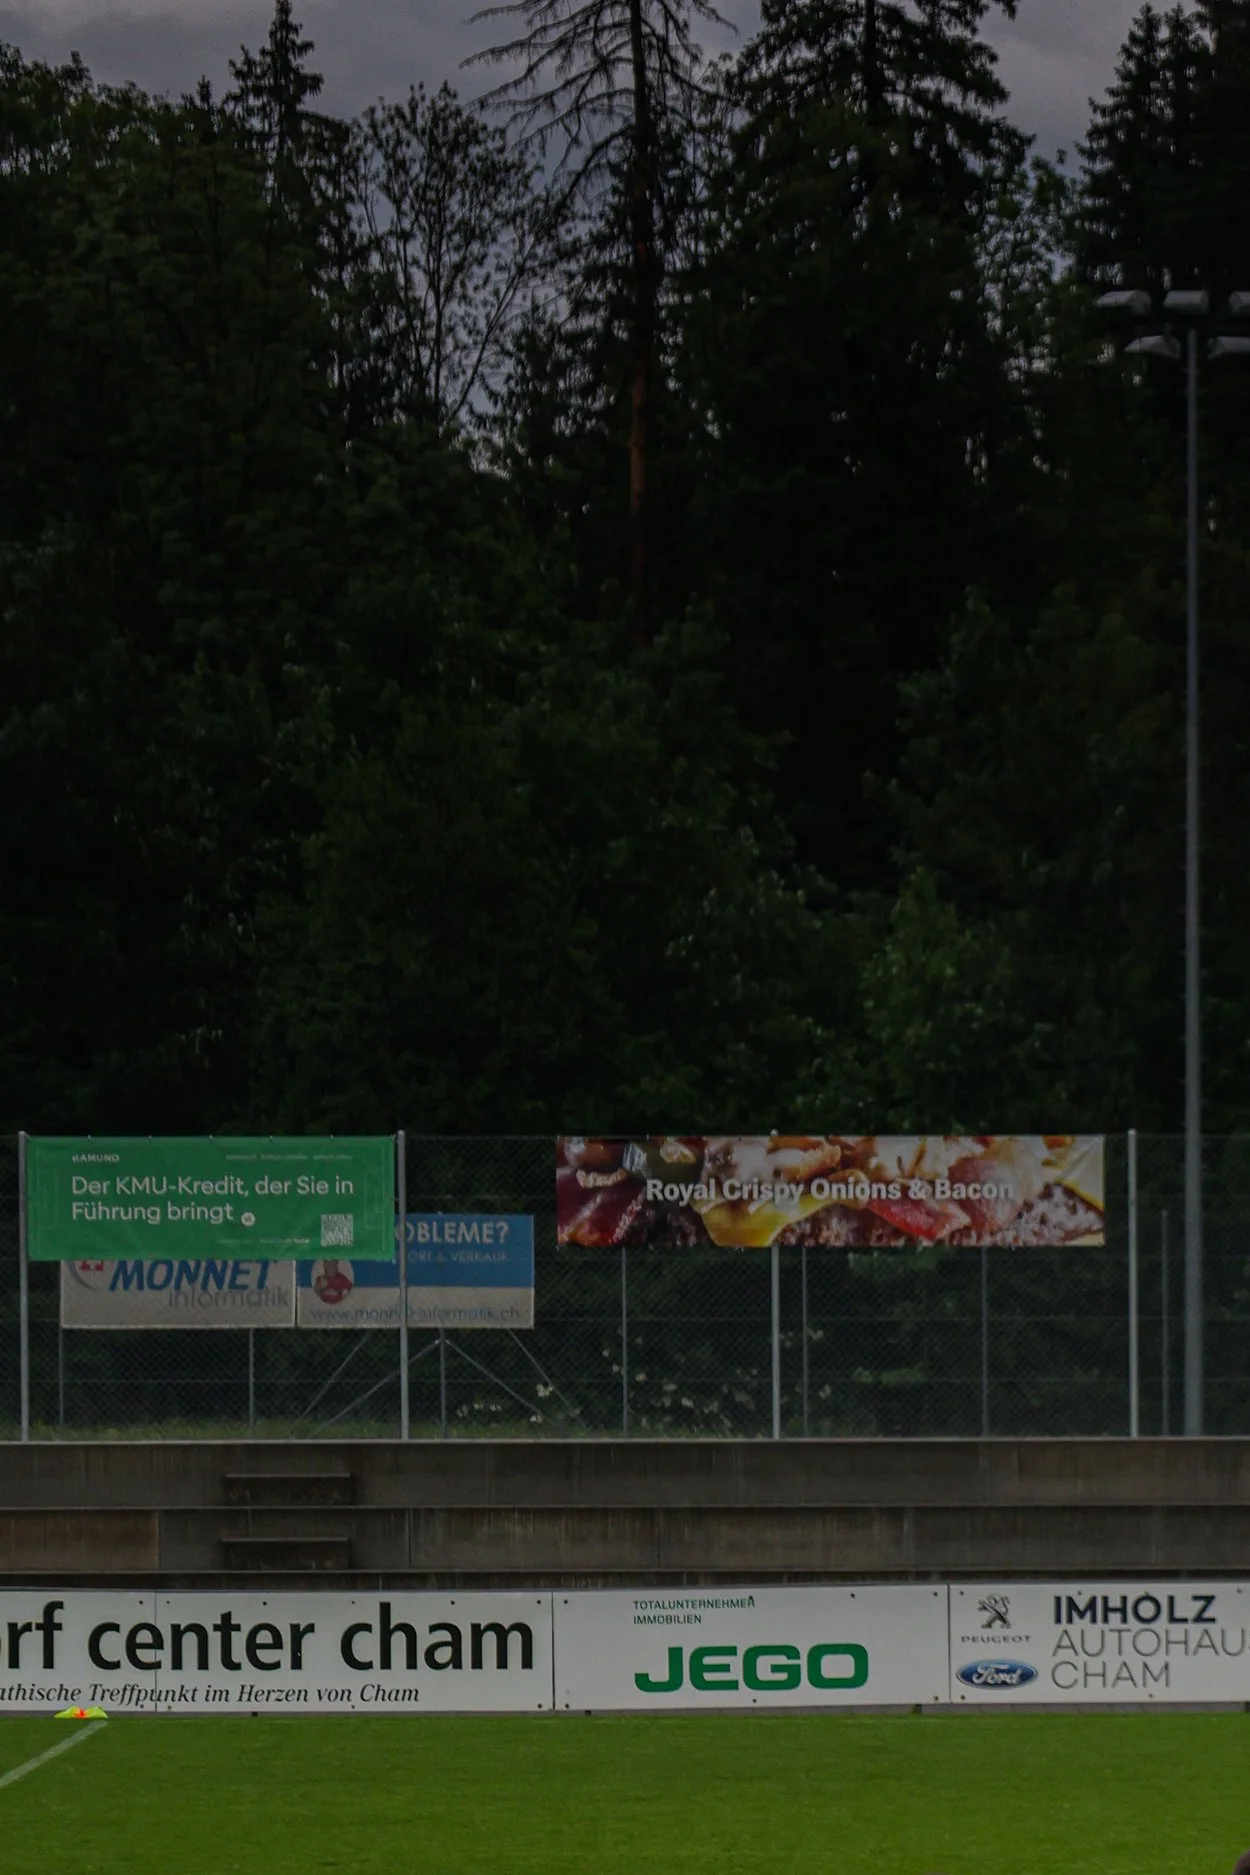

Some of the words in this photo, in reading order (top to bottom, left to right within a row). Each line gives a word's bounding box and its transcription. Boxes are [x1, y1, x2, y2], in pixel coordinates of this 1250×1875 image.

[72, 1175, 110, 1195] Der
[116, 1175, 249, 1197] KMU-Kredit,
[255, 1175, 292, 1195] der
[296, 1175, 329, 1195] Sie
[335, 1175, 354, 1195] in
[646, 1178, 716, 1206] Royal
[722, 1178, 804, 1206] Crispy
[810, 1178, 901, 1201] Onions
[909, 1178, 929, 1201] &
[934, 1178, 1015, 1201] Bacon
[72, 1200, 161, 1225] Führung
[167, 1200, 234, 1225] bringt
[396, 1221, 509, 1244] OBLEME?
[109, 1260, 279, 1291] MONNET
[169, 1287, 290, 1309] informatik
[633, 1597, 756, 1610] TOTALUNTERNEHMER
[1053, 1594, 1217, 1625] IMHOLZ
[633, 1613, 703, 1625] IMMOBILIEN
[0, 1601, 64, 1669] rf
[88, 1610, 315, 1671] center
[341, 1602, 534, 1671] cham
[960, 1635, 1032, 1643] PEUGEOT
[634, 1643, 869, 1692] JEGO
[972, 1662, 1022, 1685] Ford
[1052, 1661, 1171, 1689] CHAM
[89, 1683, 199, 1707] Treffpunkt
[204, 1684, 230, 1703] im
[238, 1684, 310, 1703] Herzen
[317, 1687, 352, 1703] von
[360, 1684, 419, 1703] Cham
